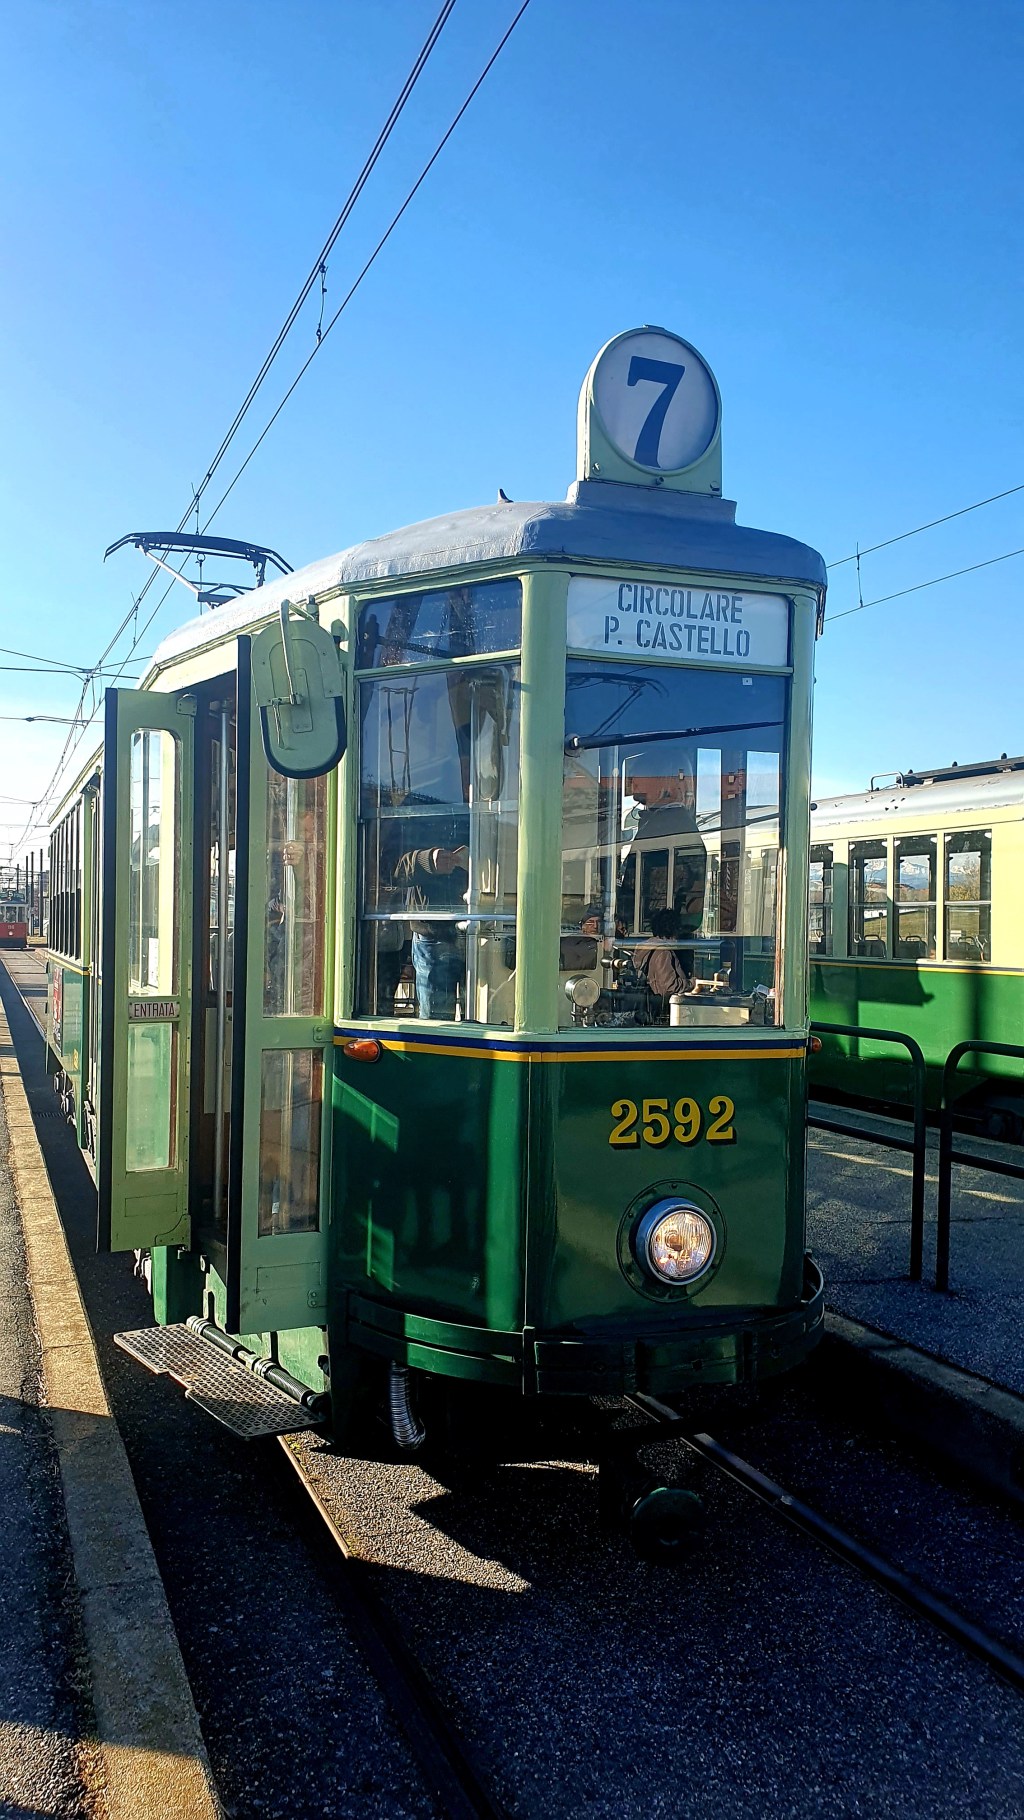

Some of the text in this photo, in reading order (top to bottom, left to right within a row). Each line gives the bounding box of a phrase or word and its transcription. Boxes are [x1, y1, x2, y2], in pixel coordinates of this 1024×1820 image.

[627, 355, 686, 469] 7
[617, 583, 743, 624] CIRCOLARE
[604, 615, 750, 657] P. CASTELLO
[134, 1002, 175, 1018] ENTRATA
[608, 1096, 737, 1149] 2592
